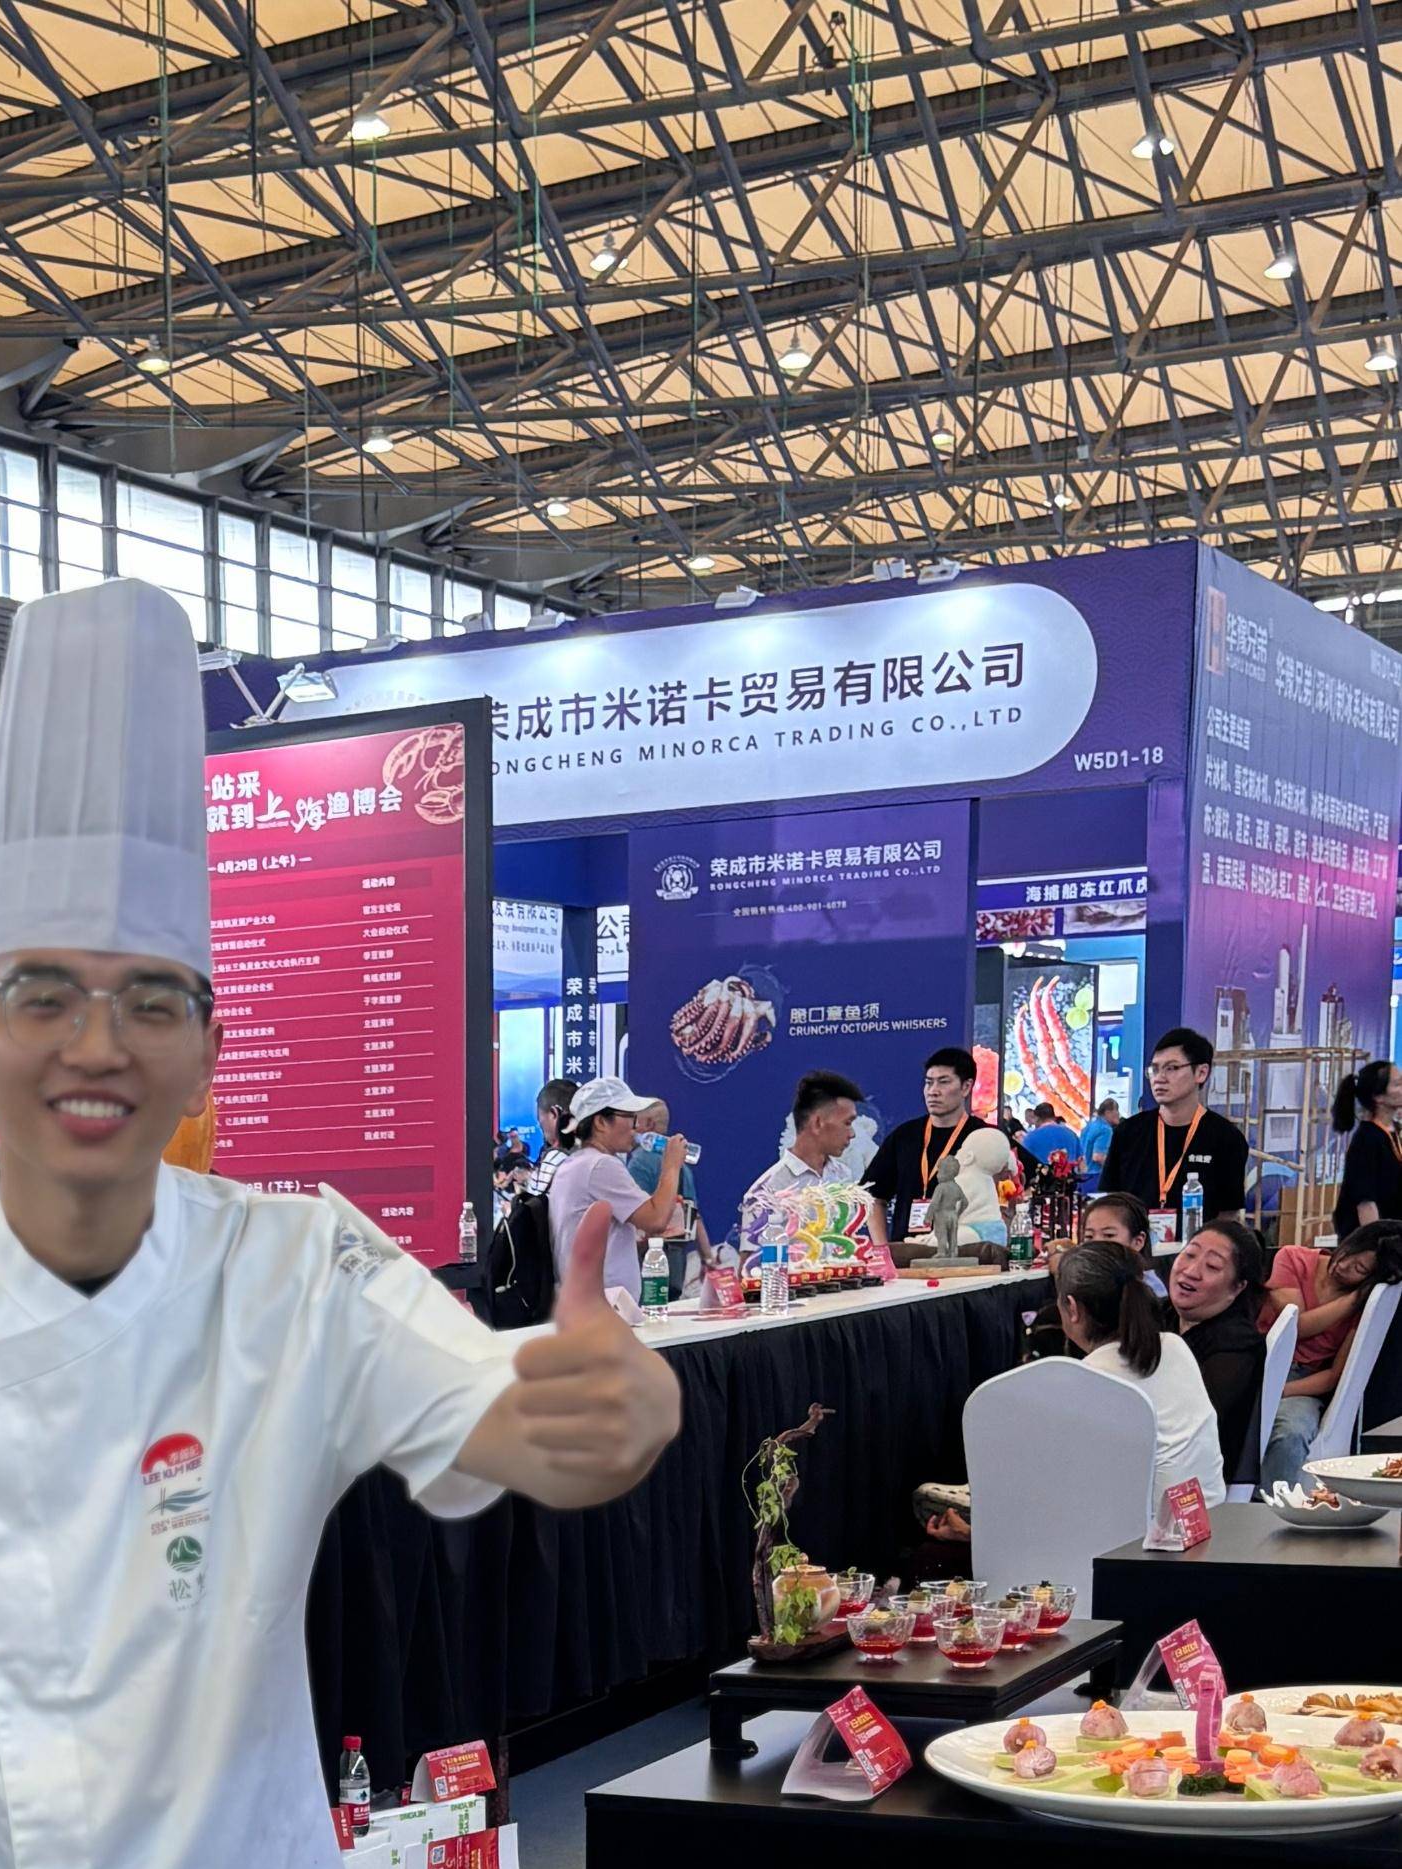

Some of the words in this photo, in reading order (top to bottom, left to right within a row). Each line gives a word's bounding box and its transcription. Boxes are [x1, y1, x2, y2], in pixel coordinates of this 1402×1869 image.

[639, 735, 759, 762] MINORCA
[775, 720, 895, 747] TRADING
[912, 706, 1023, 734] CO.,LTD
[1074, 747, 1164, 772] W5D1-18
[204, 771, 261, 801] 站采
[710, 840, 942, 878] 荣成市米诺卡贸易有限公司
[710, 878, 777, 892] RONGCHENG
[782, 873, 834, 886] MINORCA
[840, 869, 890, 882] TRADING
[789, 1003, 880, 1024] 脆口章鱼须
[789, 1023, 839, 1036] CRUNCHY
[841, 1020, 890, 1034] OCTOPUS
[892, 1018, 948, 1031] WHISKERS
[565, 978, 583, 1087] 荣成市米
[142, 1470, 162, 1486] LEE
[185, 1456, 203, 1473] KEE
